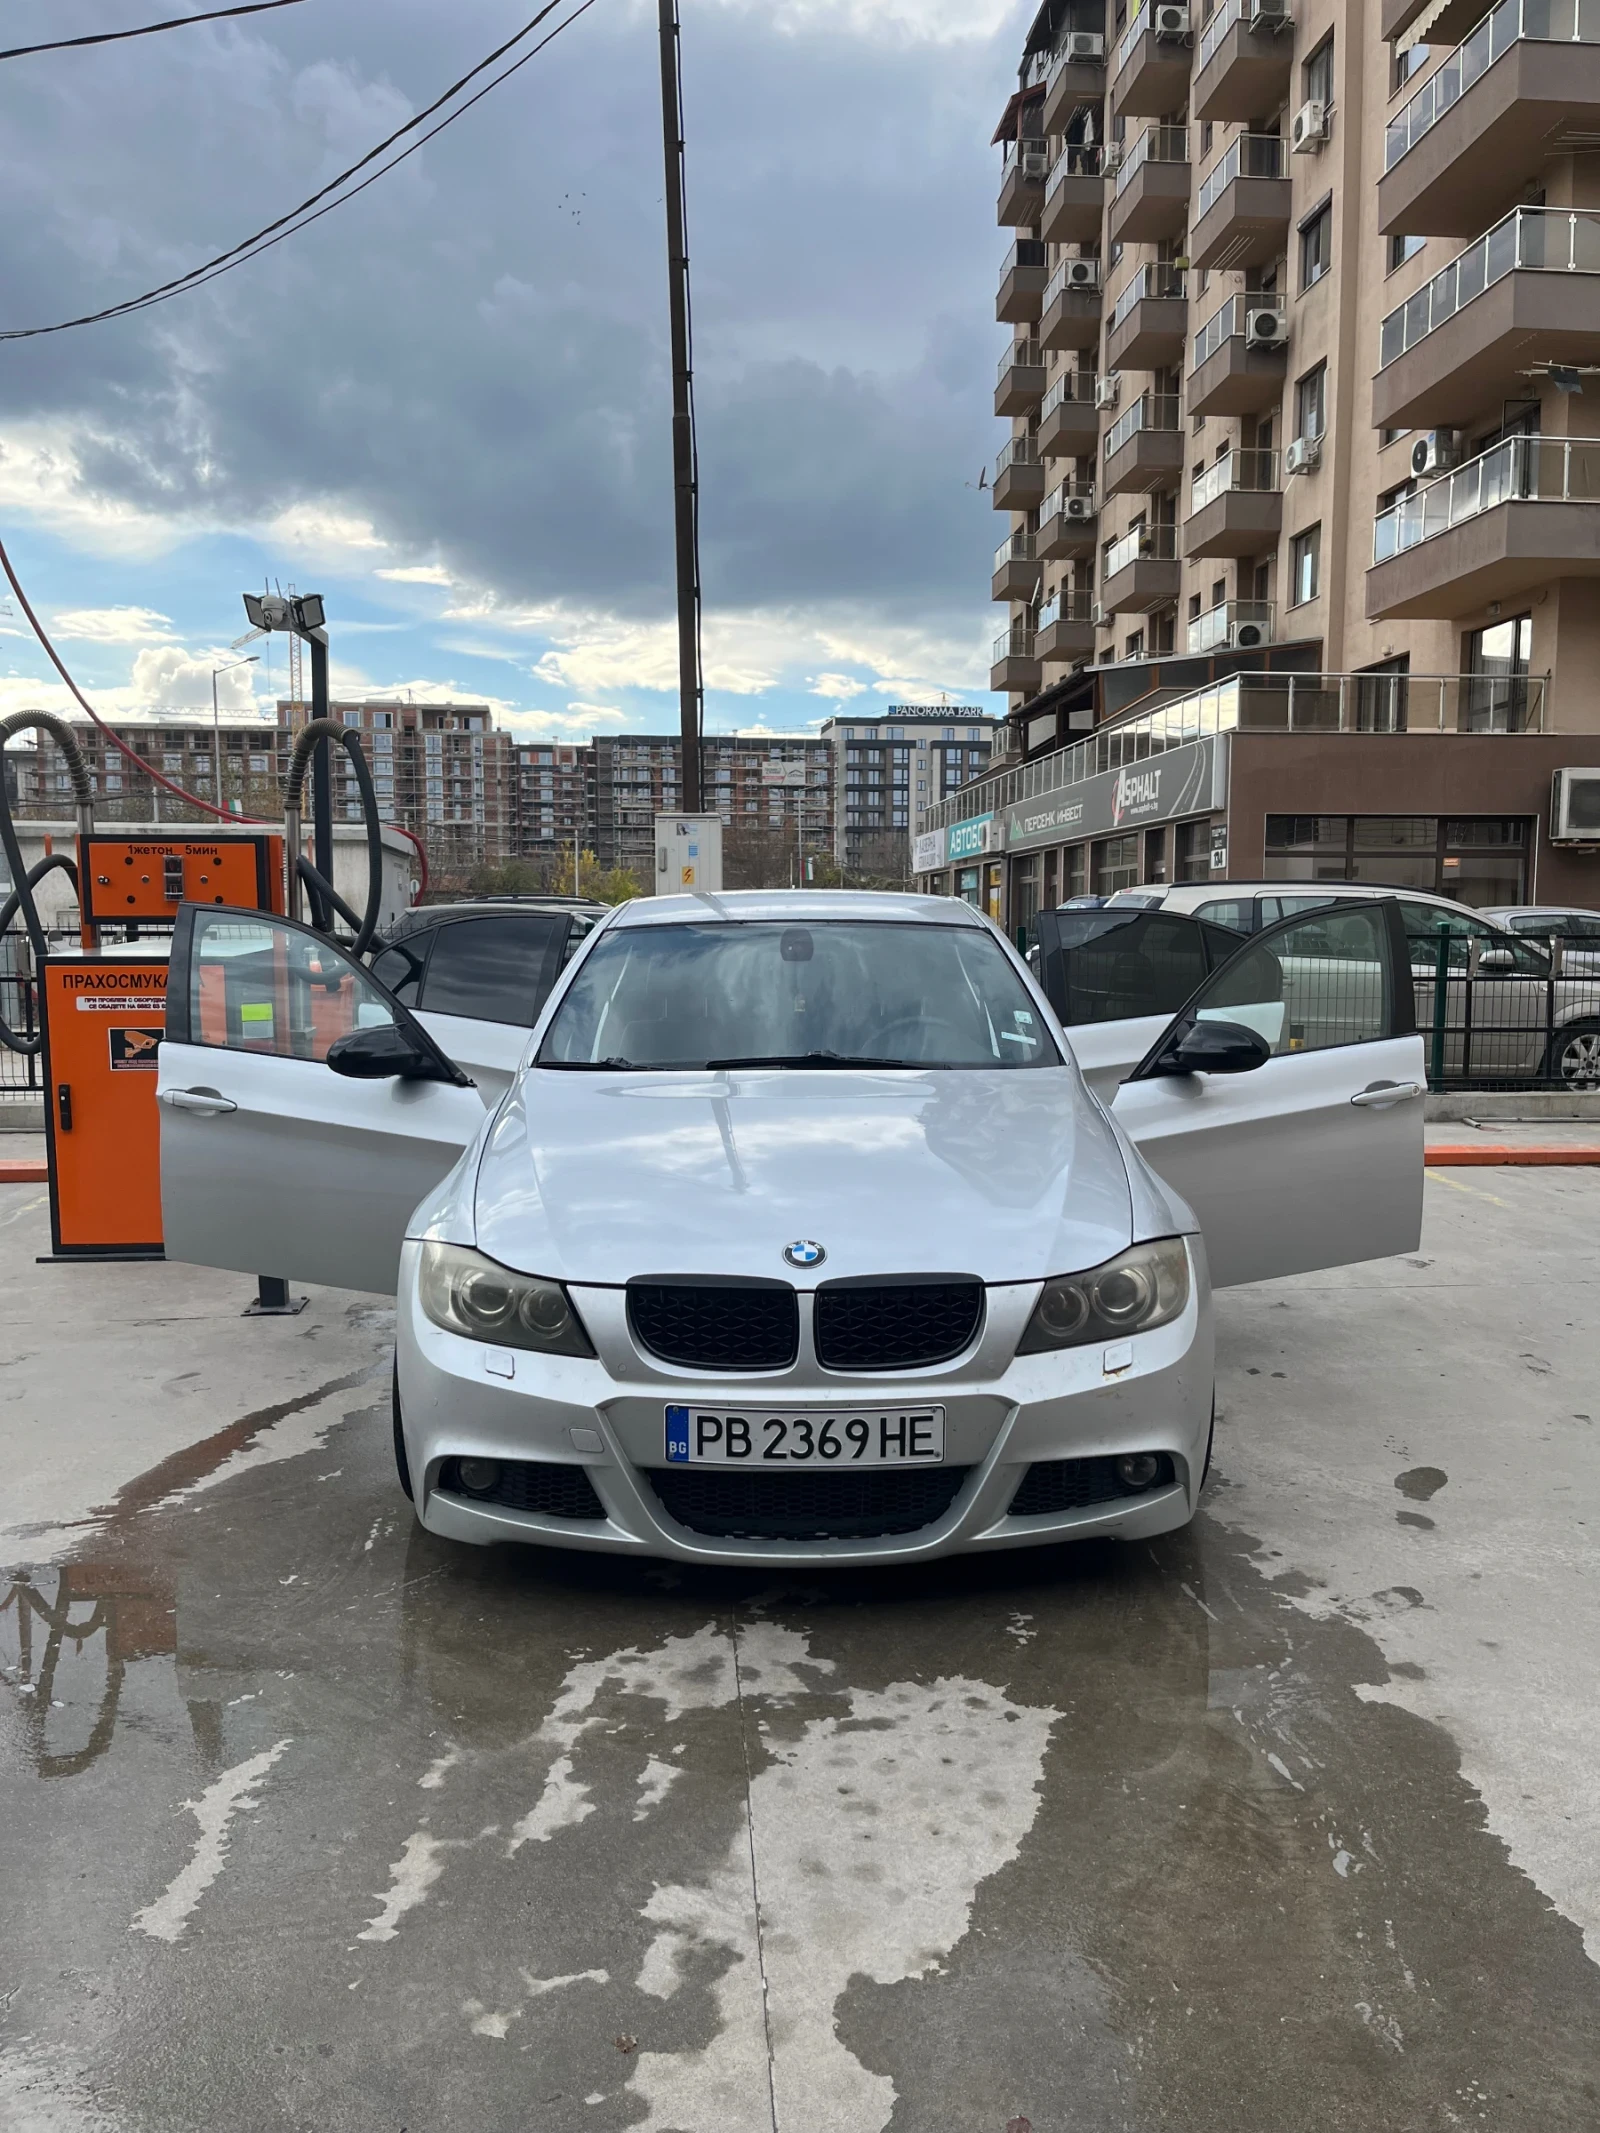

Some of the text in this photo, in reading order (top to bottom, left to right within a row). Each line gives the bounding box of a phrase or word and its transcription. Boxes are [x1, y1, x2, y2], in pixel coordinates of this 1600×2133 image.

[896, 705, 984, 717] PANORAMA PARK
[1113, 769, 1162, 827] ASPHALT
[1024, 803, 1083, 833] ПЕРСЕНК ИНВЕСТ
[127, 844, 218, 856] 1жетон 5мин
[669, 1441, 687, 1454] BG
[696, 1415, 934, 1460] PB 2369 HE
